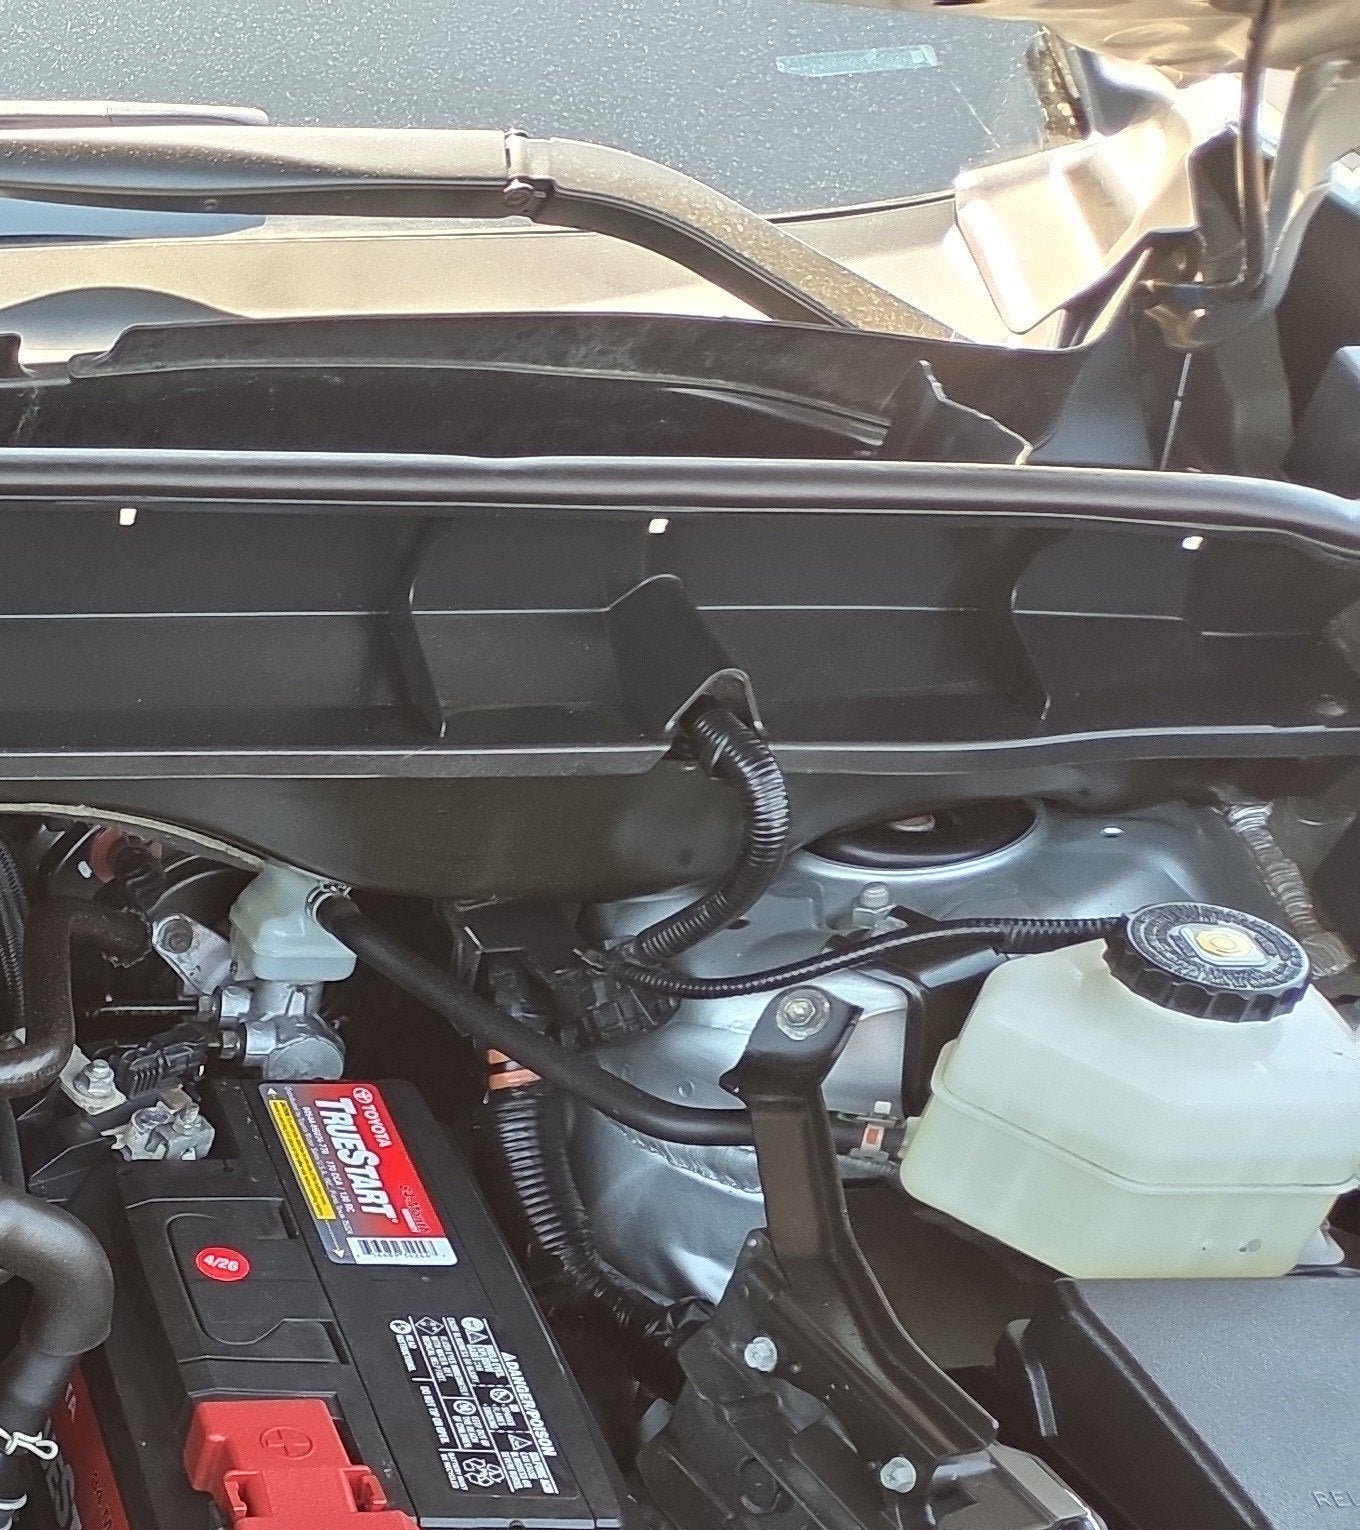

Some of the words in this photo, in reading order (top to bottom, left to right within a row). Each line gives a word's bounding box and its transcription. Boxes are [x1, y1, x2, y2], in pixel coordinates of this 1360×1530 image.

[314, 1098, 394, 1220] TRUESTART
[362, 1104, 392, 1146] TOYOTA
[505, 1361, 557, 1456] DANGER/POISON
